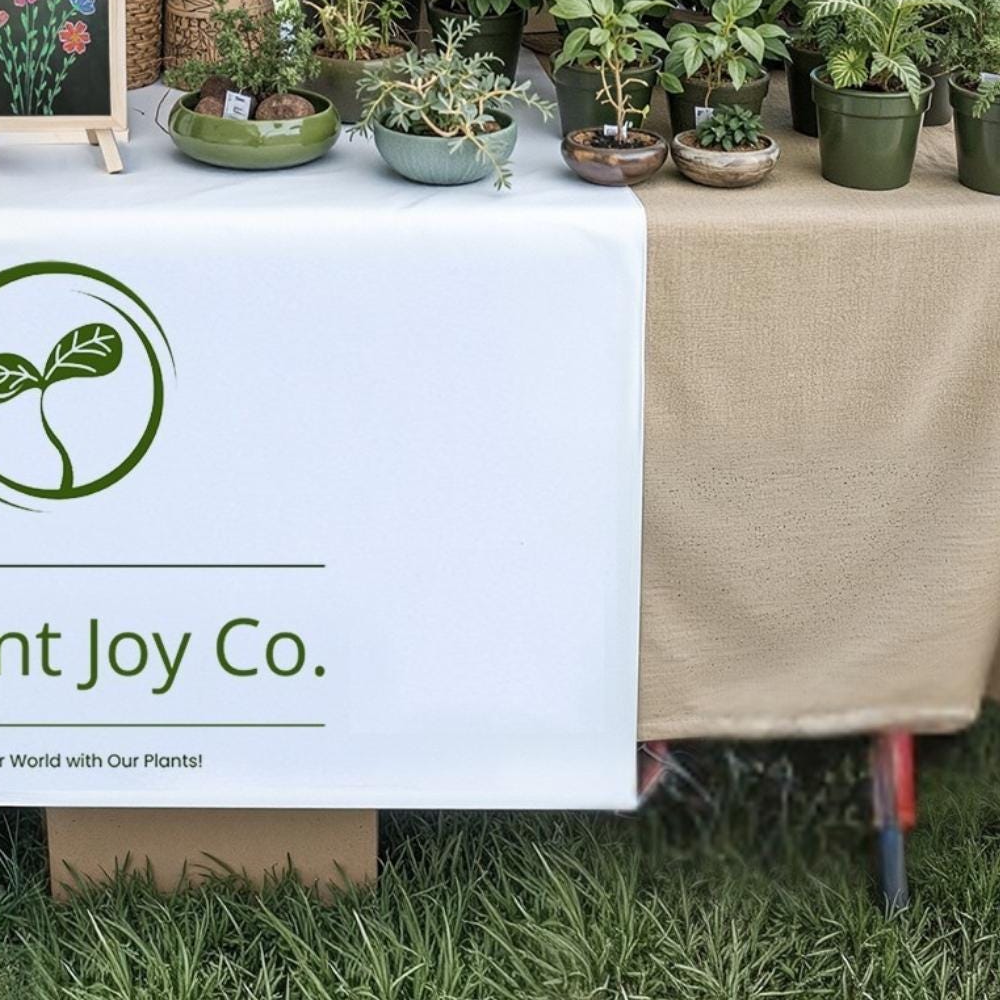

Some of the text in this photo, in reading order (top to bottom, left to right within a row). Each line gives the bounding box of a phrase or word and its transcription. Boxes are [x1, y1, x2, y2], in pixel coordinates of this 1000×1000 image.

[76, 618, 192, 695] Joy
[216, 618, 326, 677] Co.
[10, 753, 61, 769] World
[66, 753, 102, 769] with
[107, 753, 140, 769] Our
[144, 753, 202, 769] Plants!
